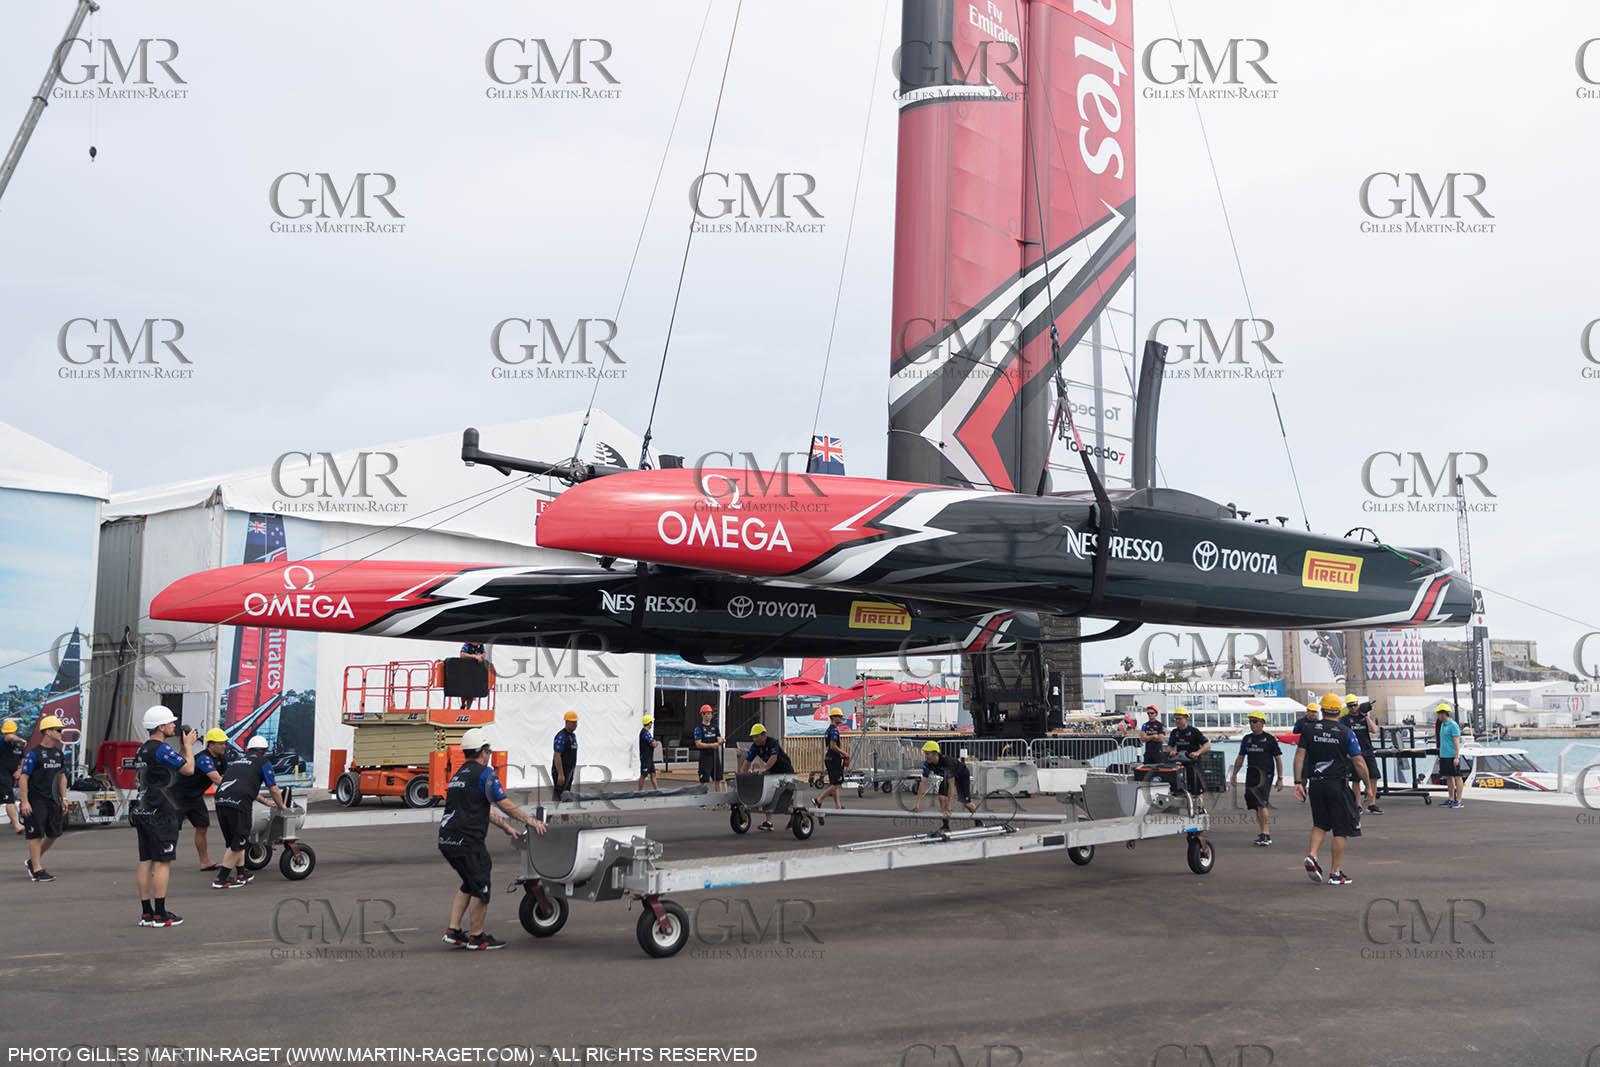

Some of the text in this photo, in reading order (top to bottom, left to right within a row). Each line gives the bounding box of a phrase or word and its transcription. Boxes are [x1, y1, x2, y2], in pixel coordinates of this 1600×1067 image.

[968, 0, 1019, 50] Fly Emirates
[1062, 436, 1126, 465] Topedo7
[657, 511, 793, 553] OMEGA
[1062, 525, 1357, 585] NESRESSO TOYOTA PIRELLI
[244, 592, 355, 619] OMEGA
[598, 589, 907, 625] NESRESSO TOYOTA PIRELLI
